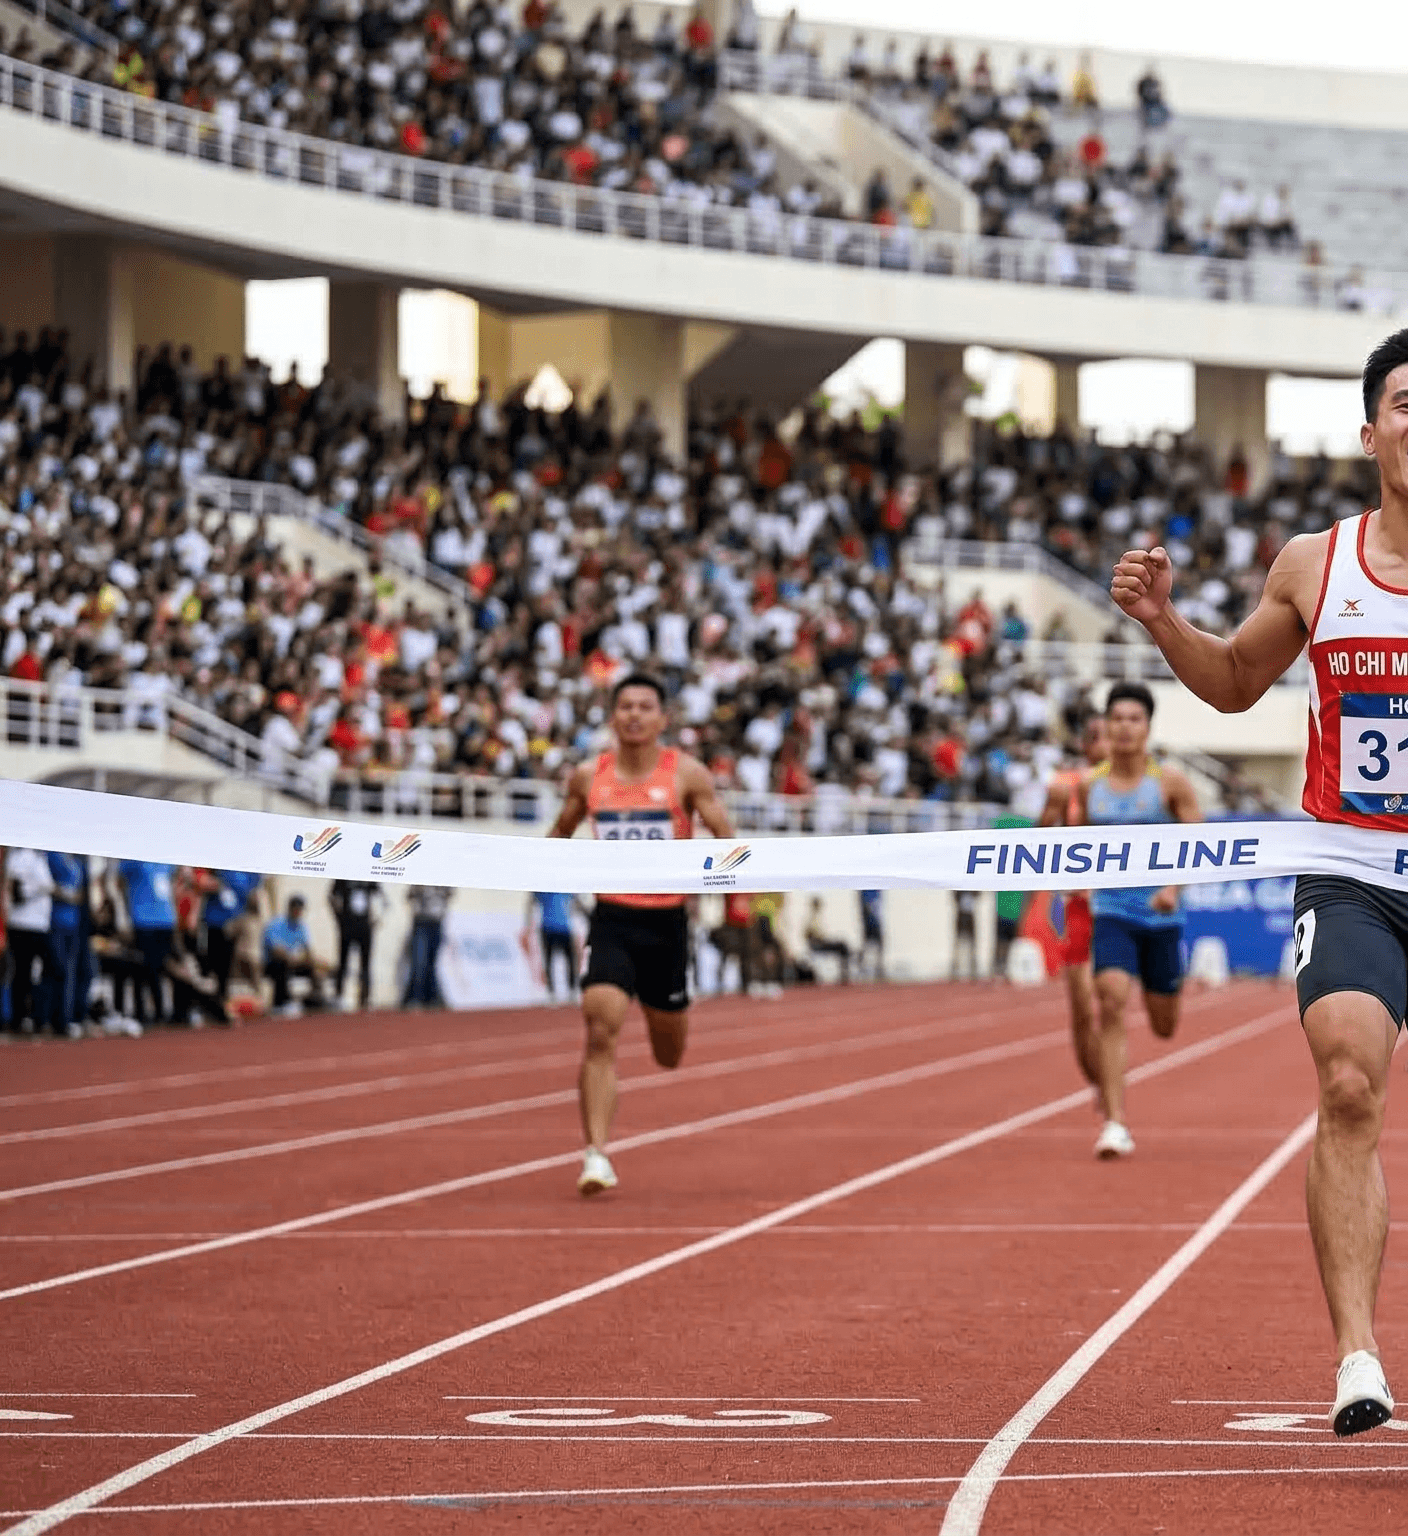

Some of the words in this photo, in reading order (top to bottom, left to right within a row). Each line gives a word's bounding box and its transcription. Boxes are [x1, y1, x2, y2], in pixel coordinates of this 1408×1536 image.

[1328, 652, 1350, 676] HO
[1355, 651, 1386, 676] CHI
[966, 842, 1132, 875] FINISH
[1147, 838, 1260, 871] LINE
